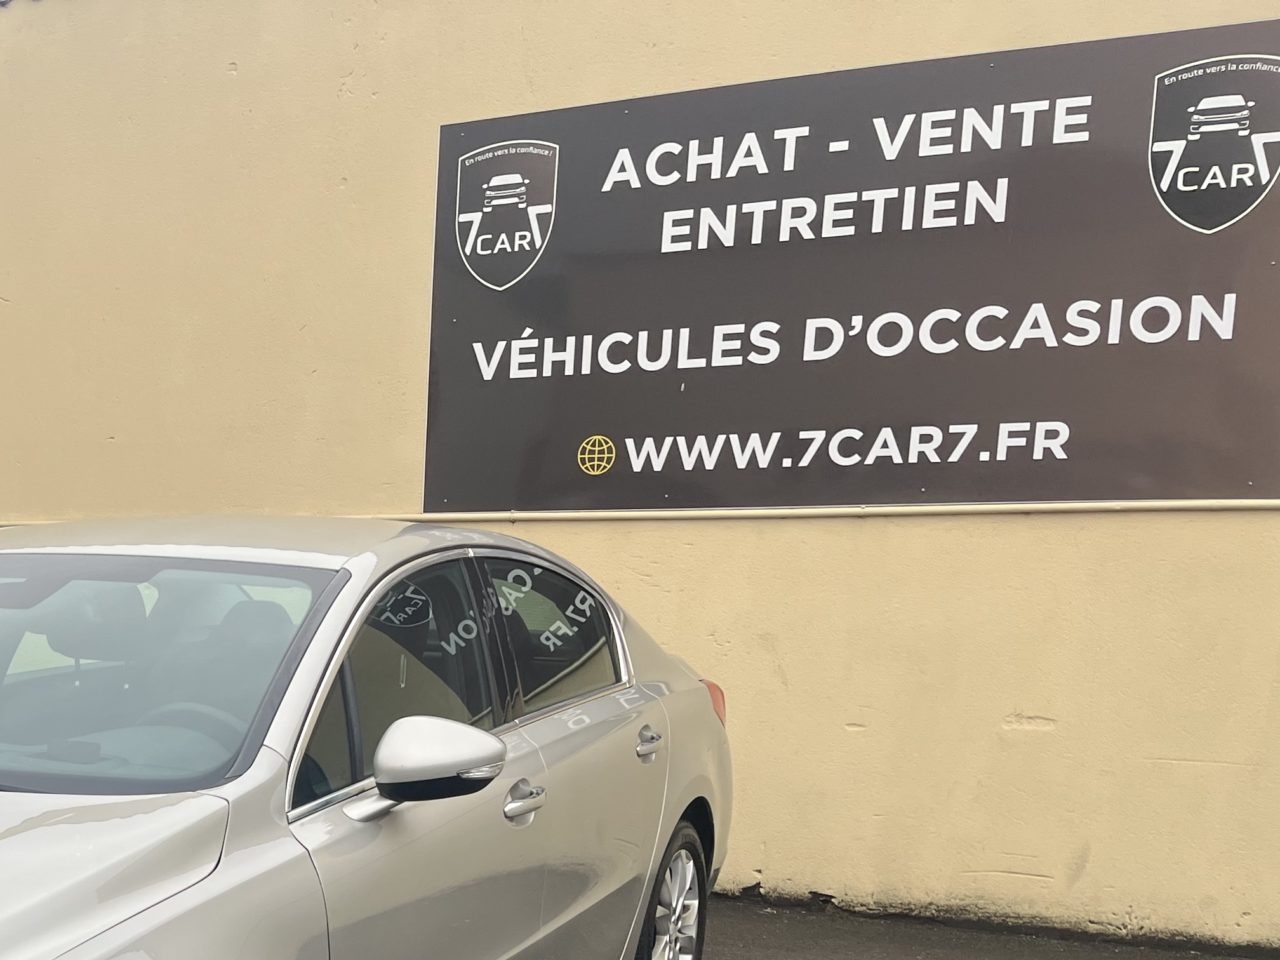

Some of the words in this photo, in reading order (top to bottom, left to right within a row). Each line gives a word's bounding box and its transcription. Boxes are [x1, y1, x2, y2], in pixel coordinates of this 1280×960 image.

[1164, 76, 1177, 86] En
[1178, 69, 1204, 81] route
[1206, 65, 1226, 75] vers
[1227, 62, 1237, 71] la
[602, 126, 810, 192] ACHAT
[873, 96, 1092, 160] VENTE
[661, 178, 1009, 253] ENTRETIEN
[473, 322, 781, 381] VÉHICULES
[803, 293, 1237, 361] D'OCCASION
[625, 421, 1070, 472] WWW.7CAR7.FR
